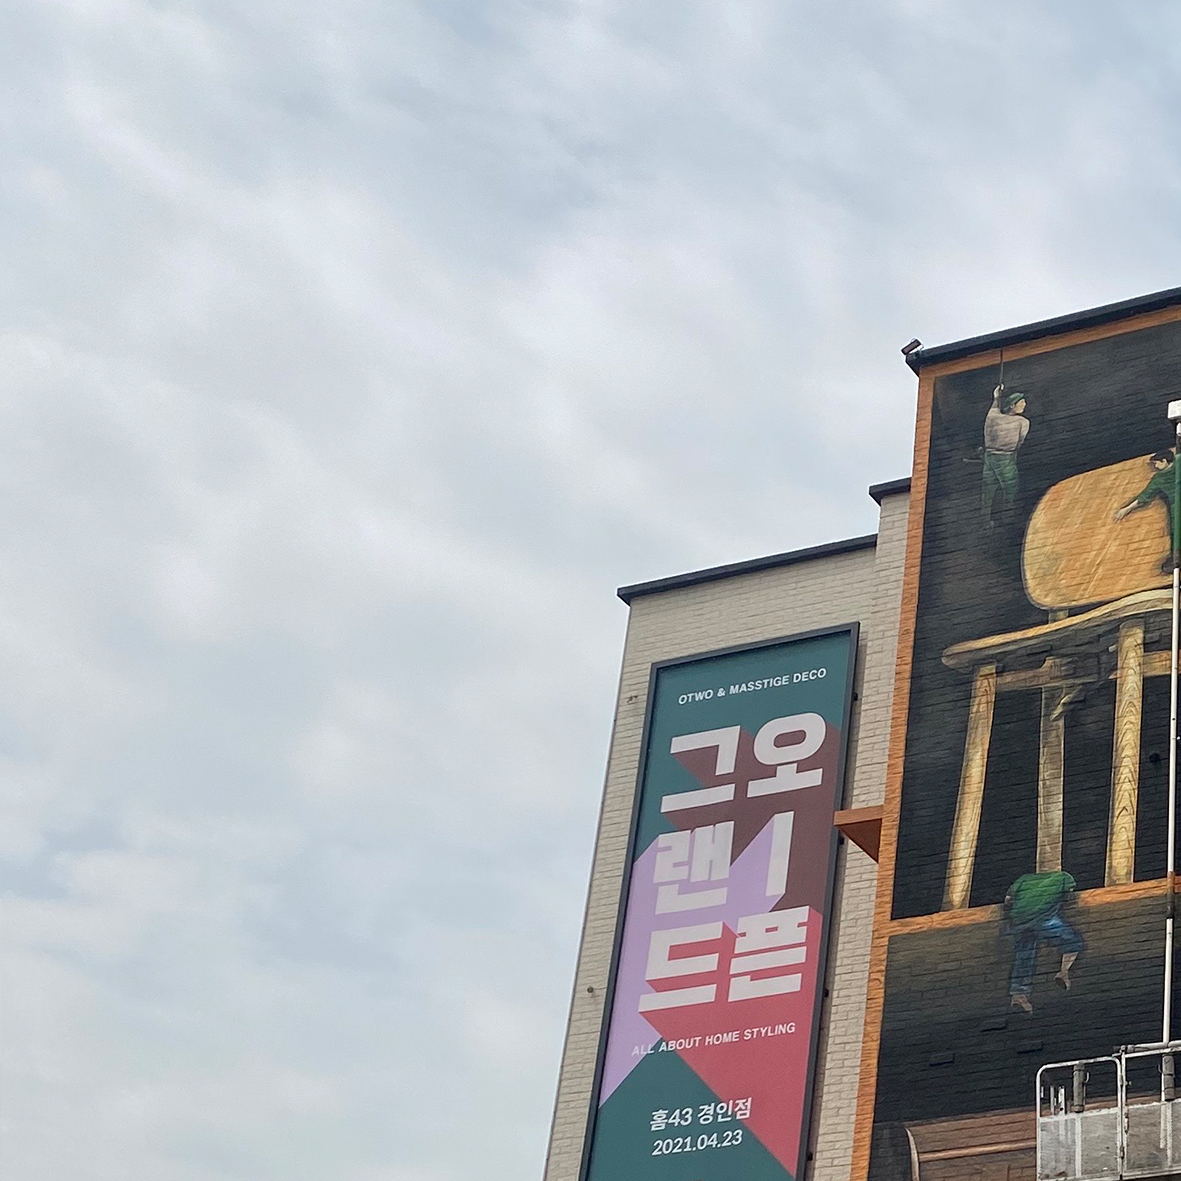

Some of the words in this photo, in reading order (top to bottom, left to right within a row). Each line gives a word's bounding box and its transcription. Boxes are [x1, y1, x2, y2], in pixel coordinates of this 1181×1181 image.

[678, 689, 714, 705] OTWO
[717, 687, 726, 697] &
[729, 675, 790, 695] MASSTIGE
[793, 668, 827, 683] DECO
[631, 1044, 656, 1056] ALL
[658, 1036, 702, 1053] ABOUT
[705, 1030, 741, 1046] HOME
[743, 1022, 796, 1040] STYLING
[650, 1107, 693, 1132] 홈43
[697, 1097, 752, 1125] 경인점
[651, 1129, 743, 1156] 2021.04.23
